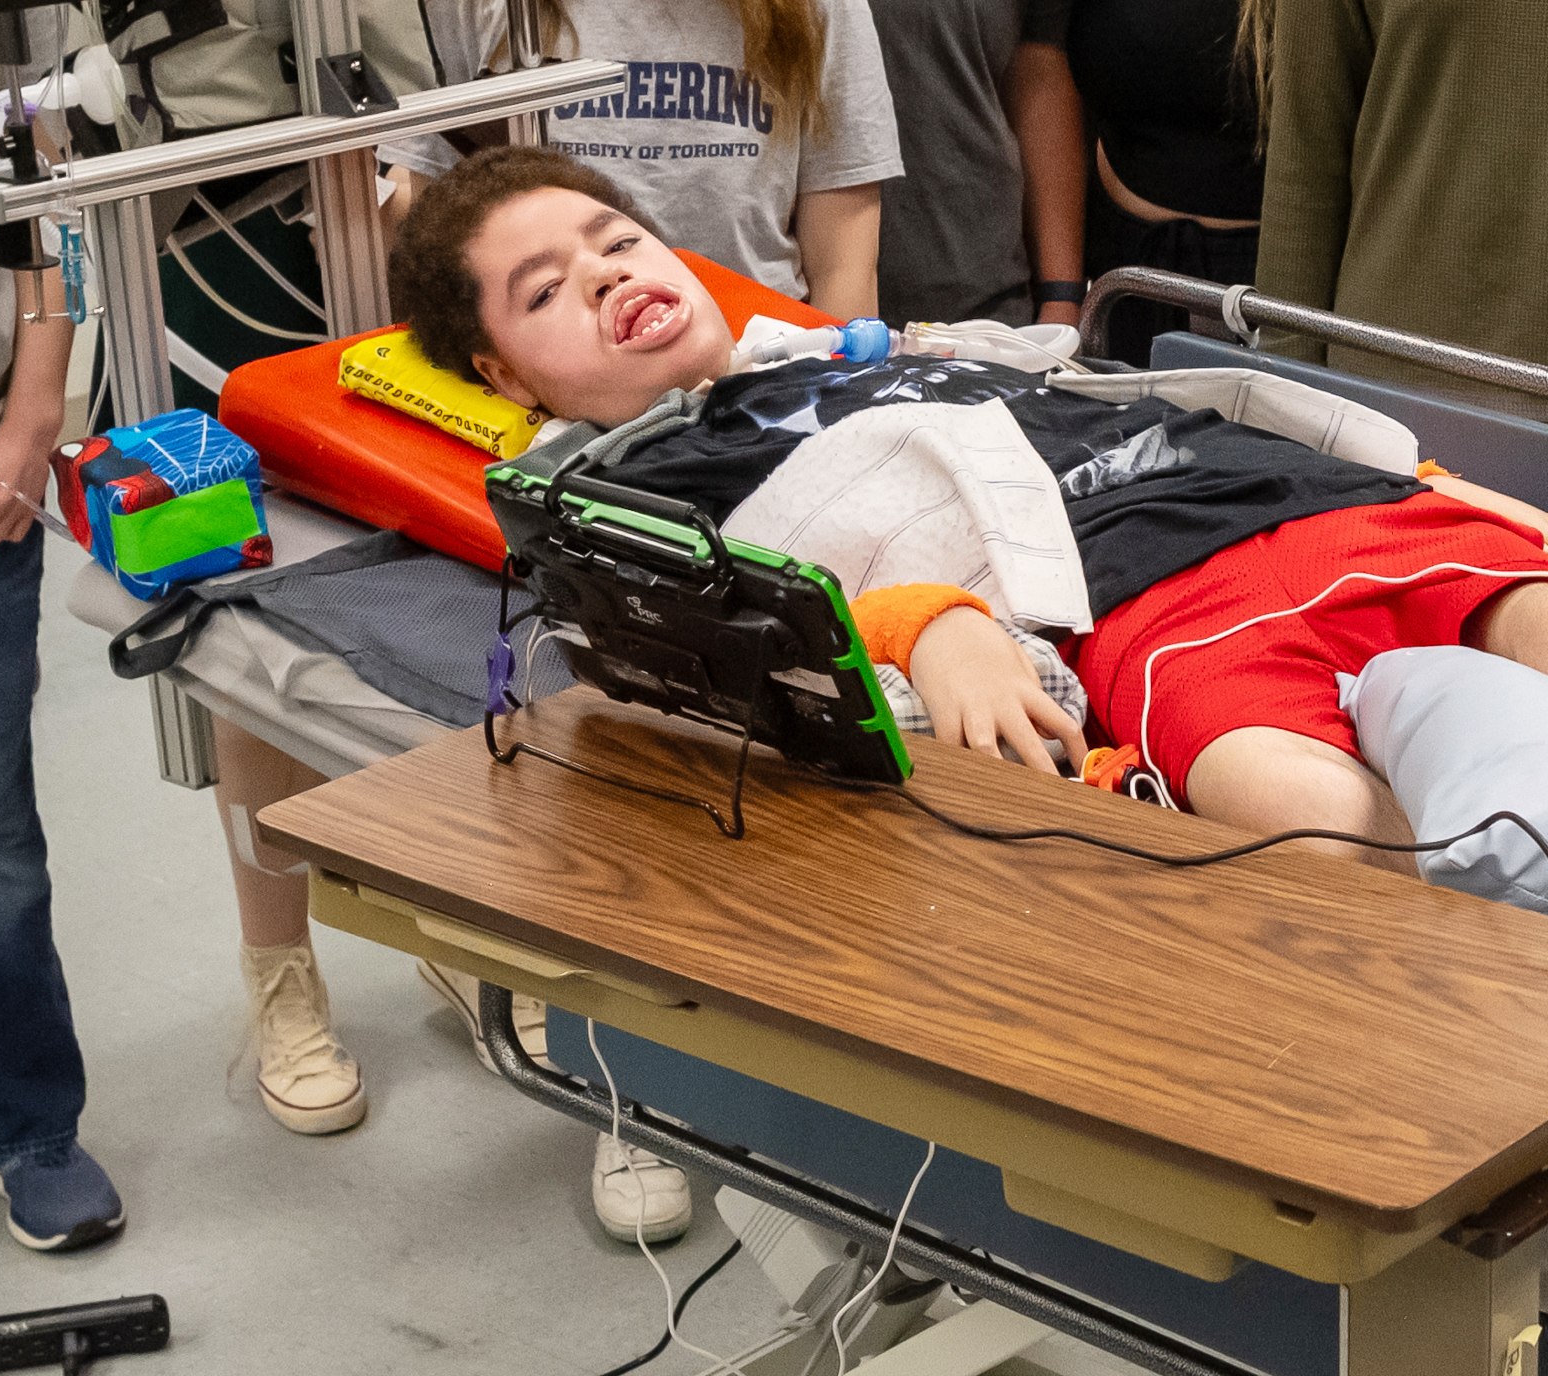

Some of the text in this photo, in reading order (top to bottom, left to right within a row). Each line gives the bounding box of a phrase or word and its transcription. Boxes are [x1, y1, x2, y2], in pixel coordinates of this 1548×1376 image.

[638, 145, 664, 160] OF
[668, 142, 760, 160] TORONTO
[637, 607, 663, 622] PRC
